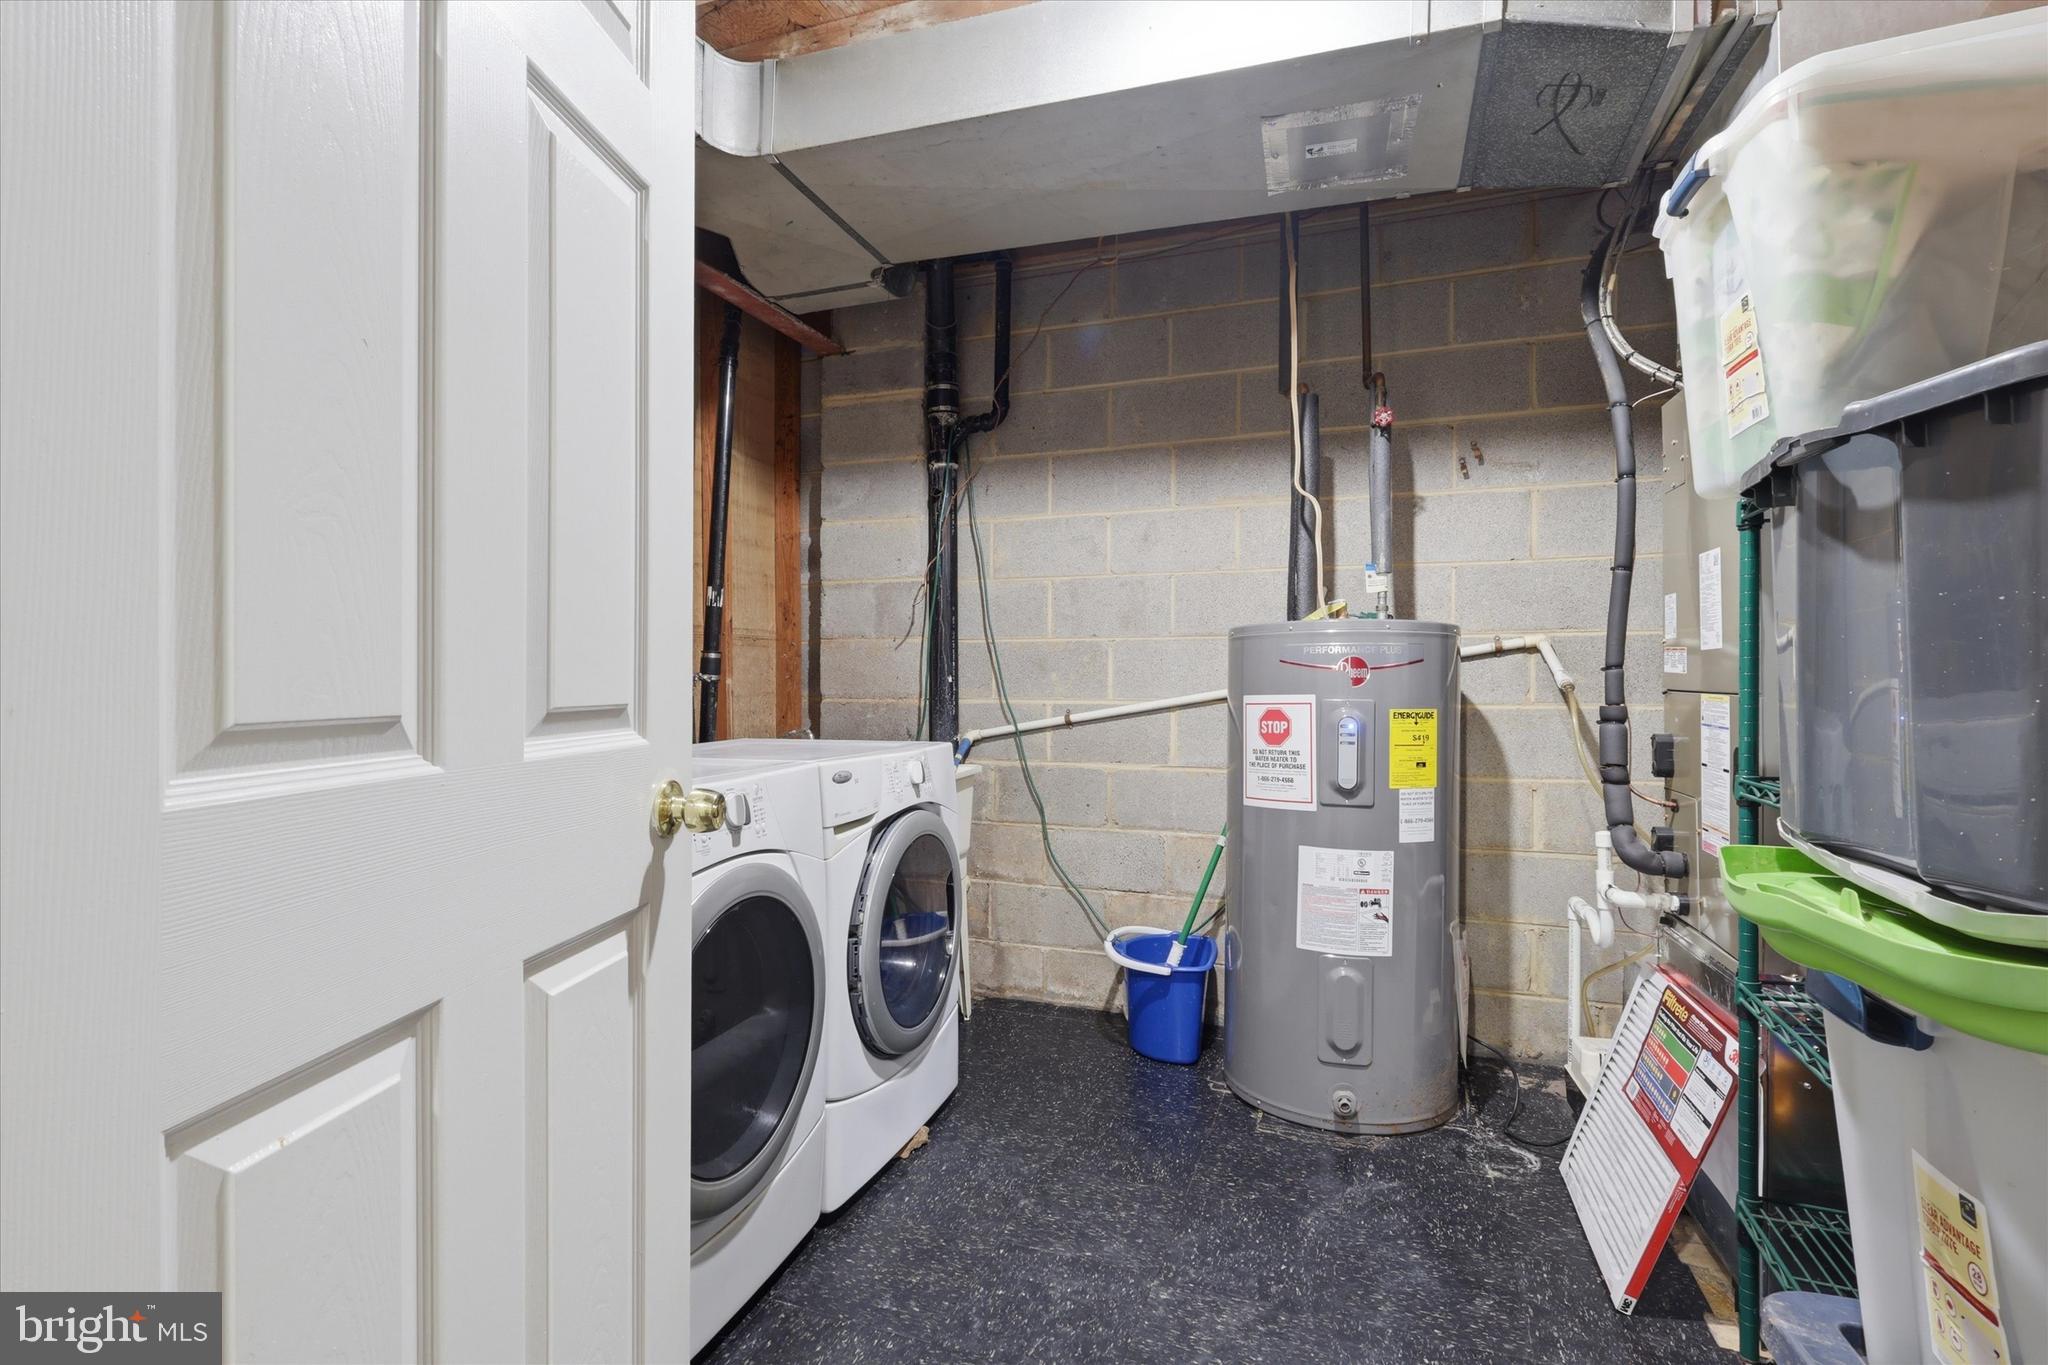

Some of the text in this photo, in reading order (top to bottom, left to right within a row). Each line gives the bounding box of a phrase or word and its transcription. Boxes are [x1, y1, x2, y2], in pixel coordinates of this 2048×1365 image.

[1304, 646, 1402, 655] PERFORMANCE PLUS
[1261, 720, 1288, 734] STOP
[1257, 761, 1270, 769] PLACE
[1662, 988, 1689, 1023] Filtrete
[1939, 1214, 1983, 1261] ADVANTAGE
